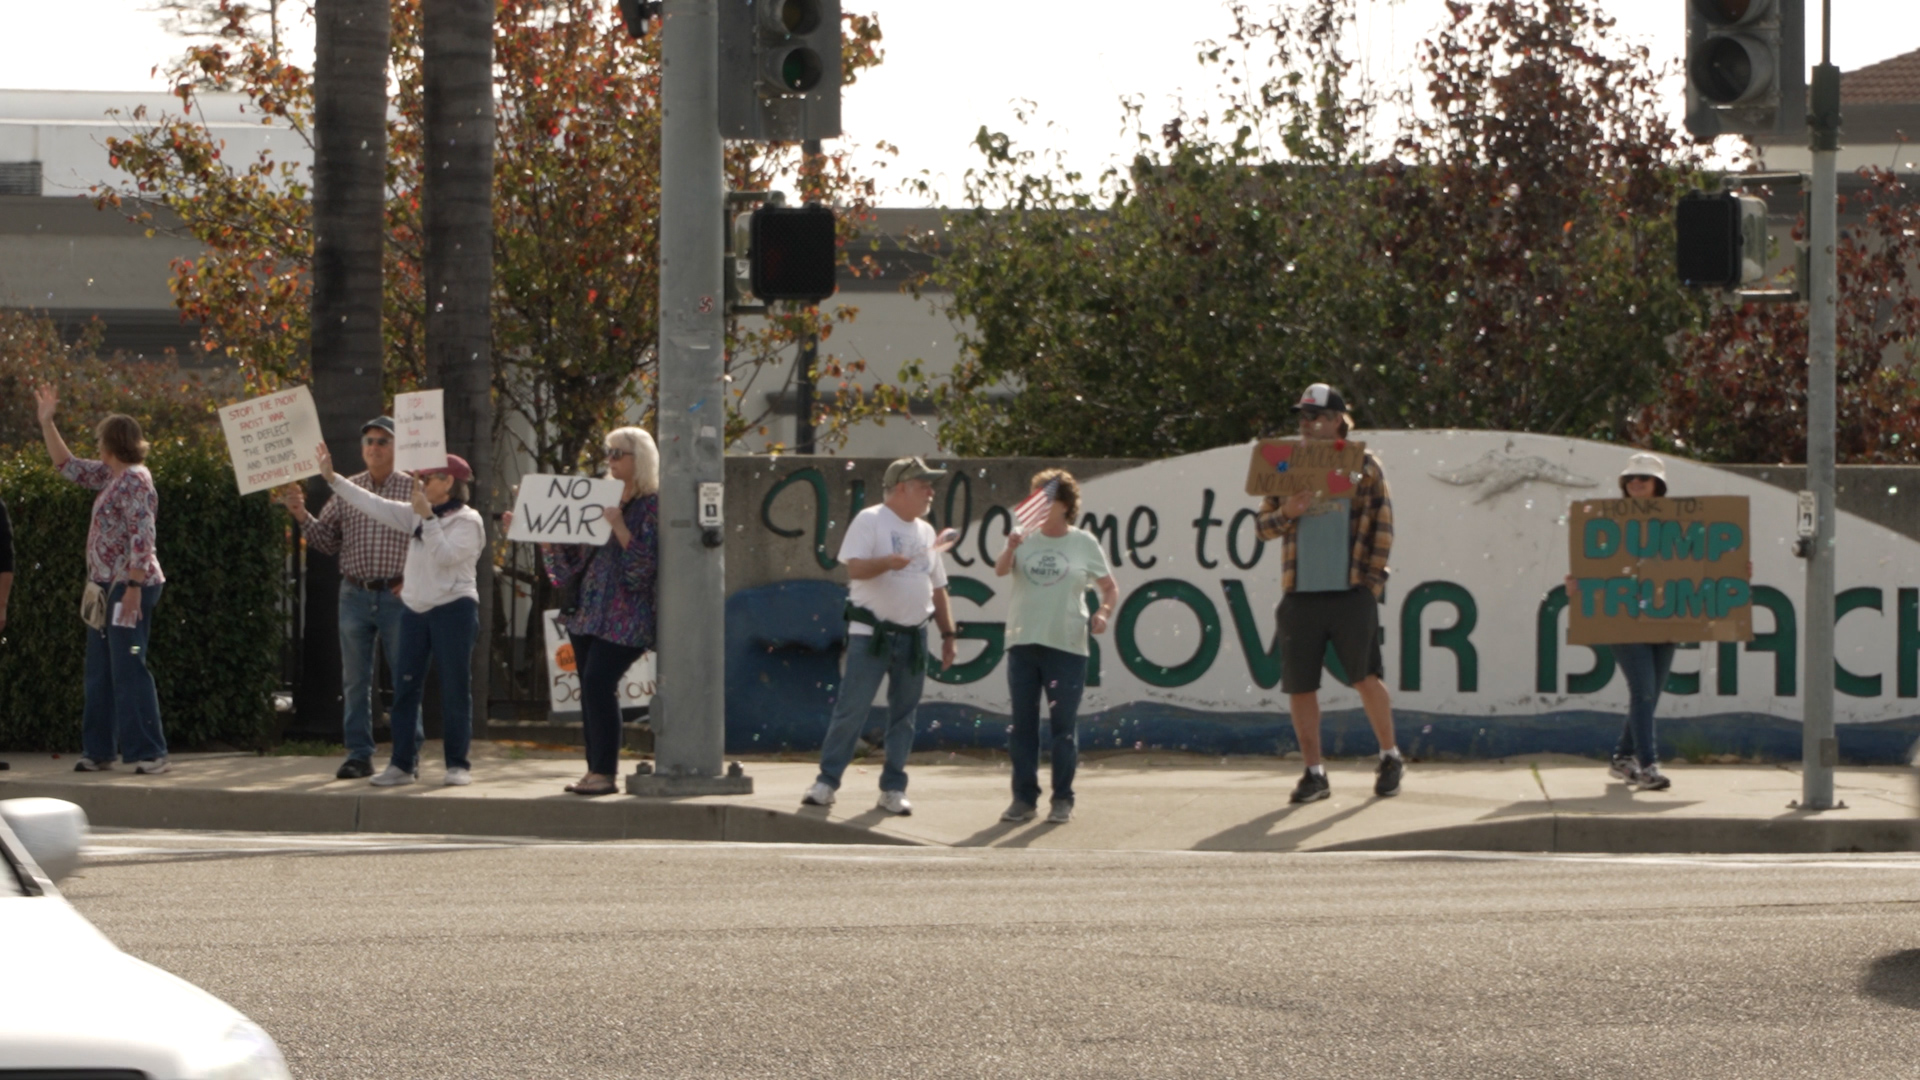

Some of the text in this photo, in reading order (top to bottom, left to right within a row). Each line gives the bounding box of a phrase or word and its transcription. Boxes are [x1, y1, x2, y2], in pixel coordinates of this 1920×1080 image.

[259, 400, 272, 411] THE
[268, 411, 286, 423] WAR
[241, 422, 290, 444] TO DEFLECT
[243, 437, 294, 457] THE EPSTEIN
[247, 461, 262, 471] AND
[248, 459, 314, 484] PEDOPHILE FILES
[547, 478, 591, 500] NO
[1254, 472, 1275, 493] NO
[1602, 499, 1662, 517] HONK
[523, 503, 605, 537] WAR
[1192, 488, 1259, 570] to
[1583, 518, 1743, 562] DUMP
[1577, 576, 1751, 619] TRUMP
